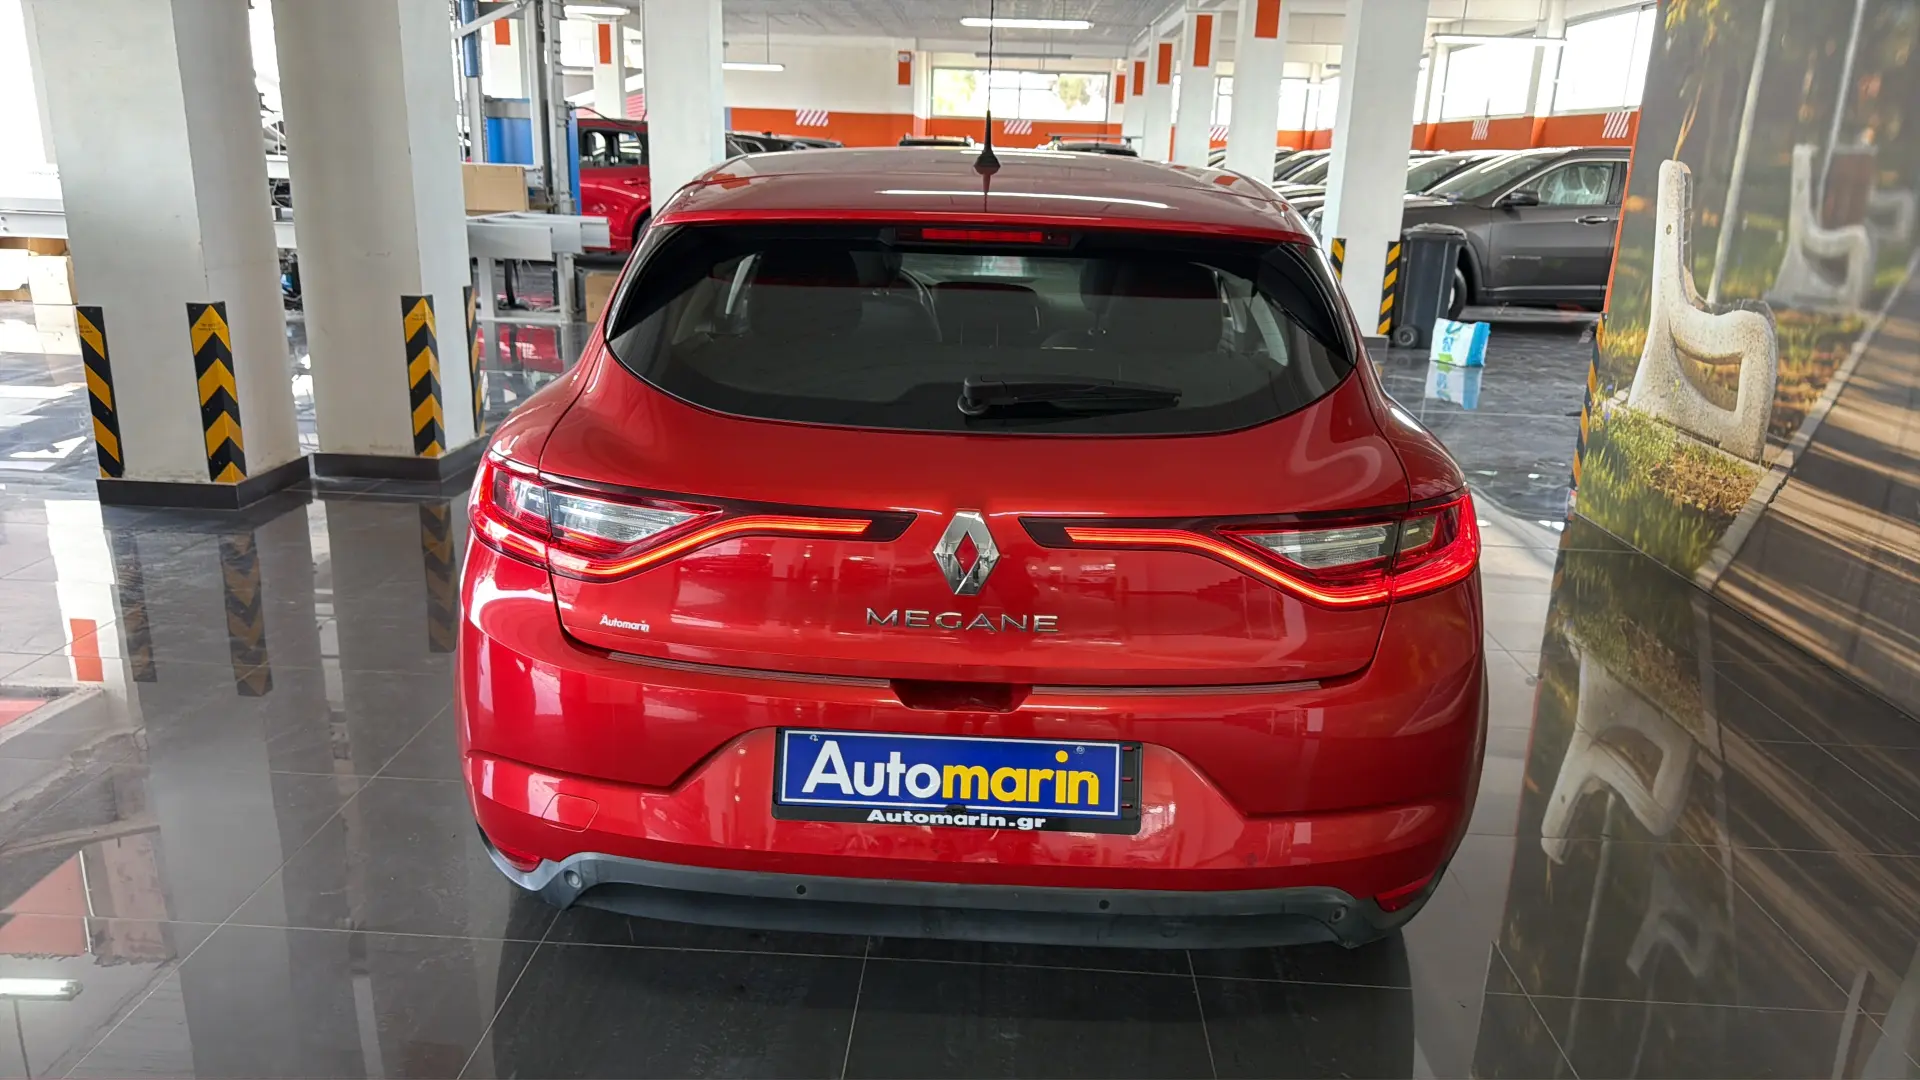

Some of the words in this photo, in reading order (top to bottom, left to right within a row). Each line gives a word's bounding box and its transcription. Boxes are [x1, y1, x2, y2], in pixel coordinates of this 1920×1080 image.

[599, 613, 650, 632] Automarin
[866, 607, 1059, 632] MEGANE
[802, 740, 1099, 804] Automarin
[867, 809, 1046, 830] Automarin.gr
